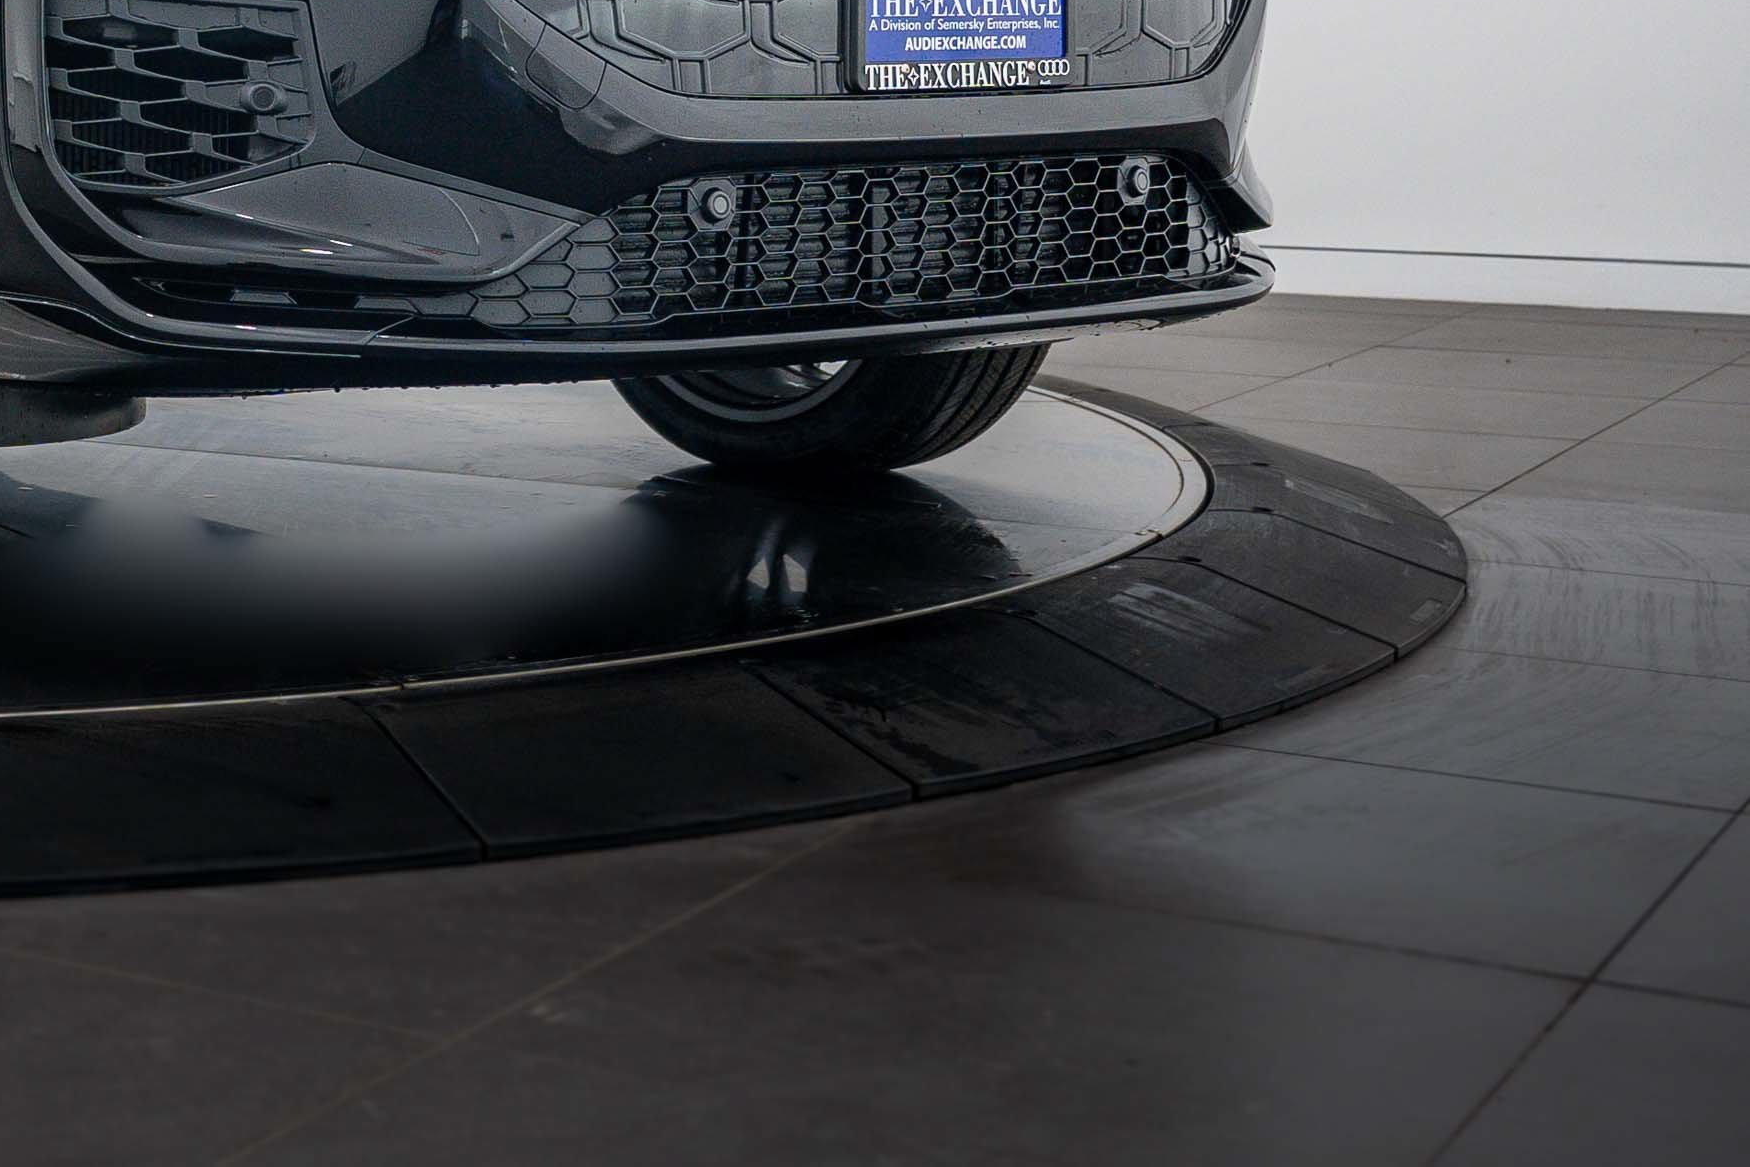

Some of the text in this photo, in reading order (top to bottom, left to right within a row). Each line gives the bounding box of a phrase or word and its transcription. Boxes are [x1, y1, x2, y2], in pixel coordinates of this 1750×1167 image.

[869, 17, 1060, 33] A Division of Semersky Enterprises, Inc.
[904, 35, 1027, 51] AUDIEXCHANGE.COM
[865, 60, 1030, 91] THE EXCHANGE
